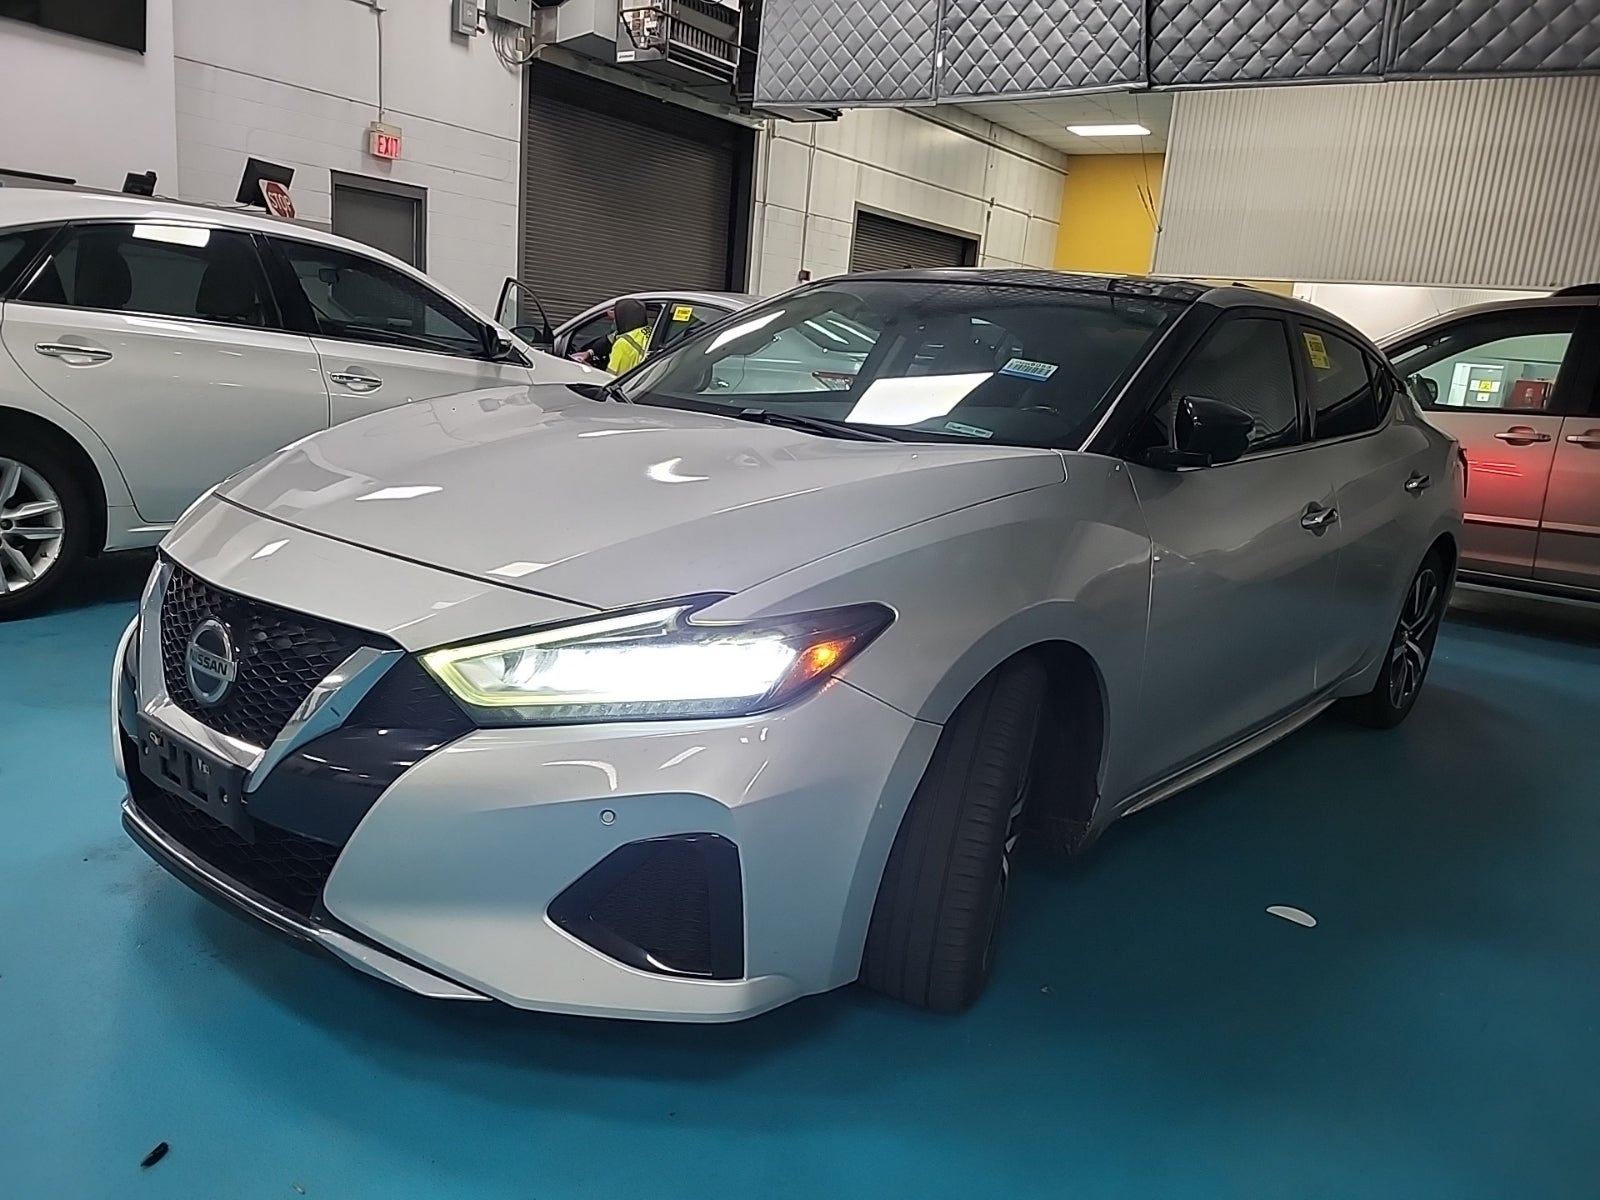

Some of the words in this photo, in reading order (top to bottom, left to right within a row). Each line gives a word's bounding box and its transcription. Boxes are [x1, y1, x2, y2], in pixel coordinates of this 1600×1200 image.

[378, 134, 399, 158] EXIT
[268, 191, 292, 217] STOP
[190, 648, 228, 676] NISSAN
